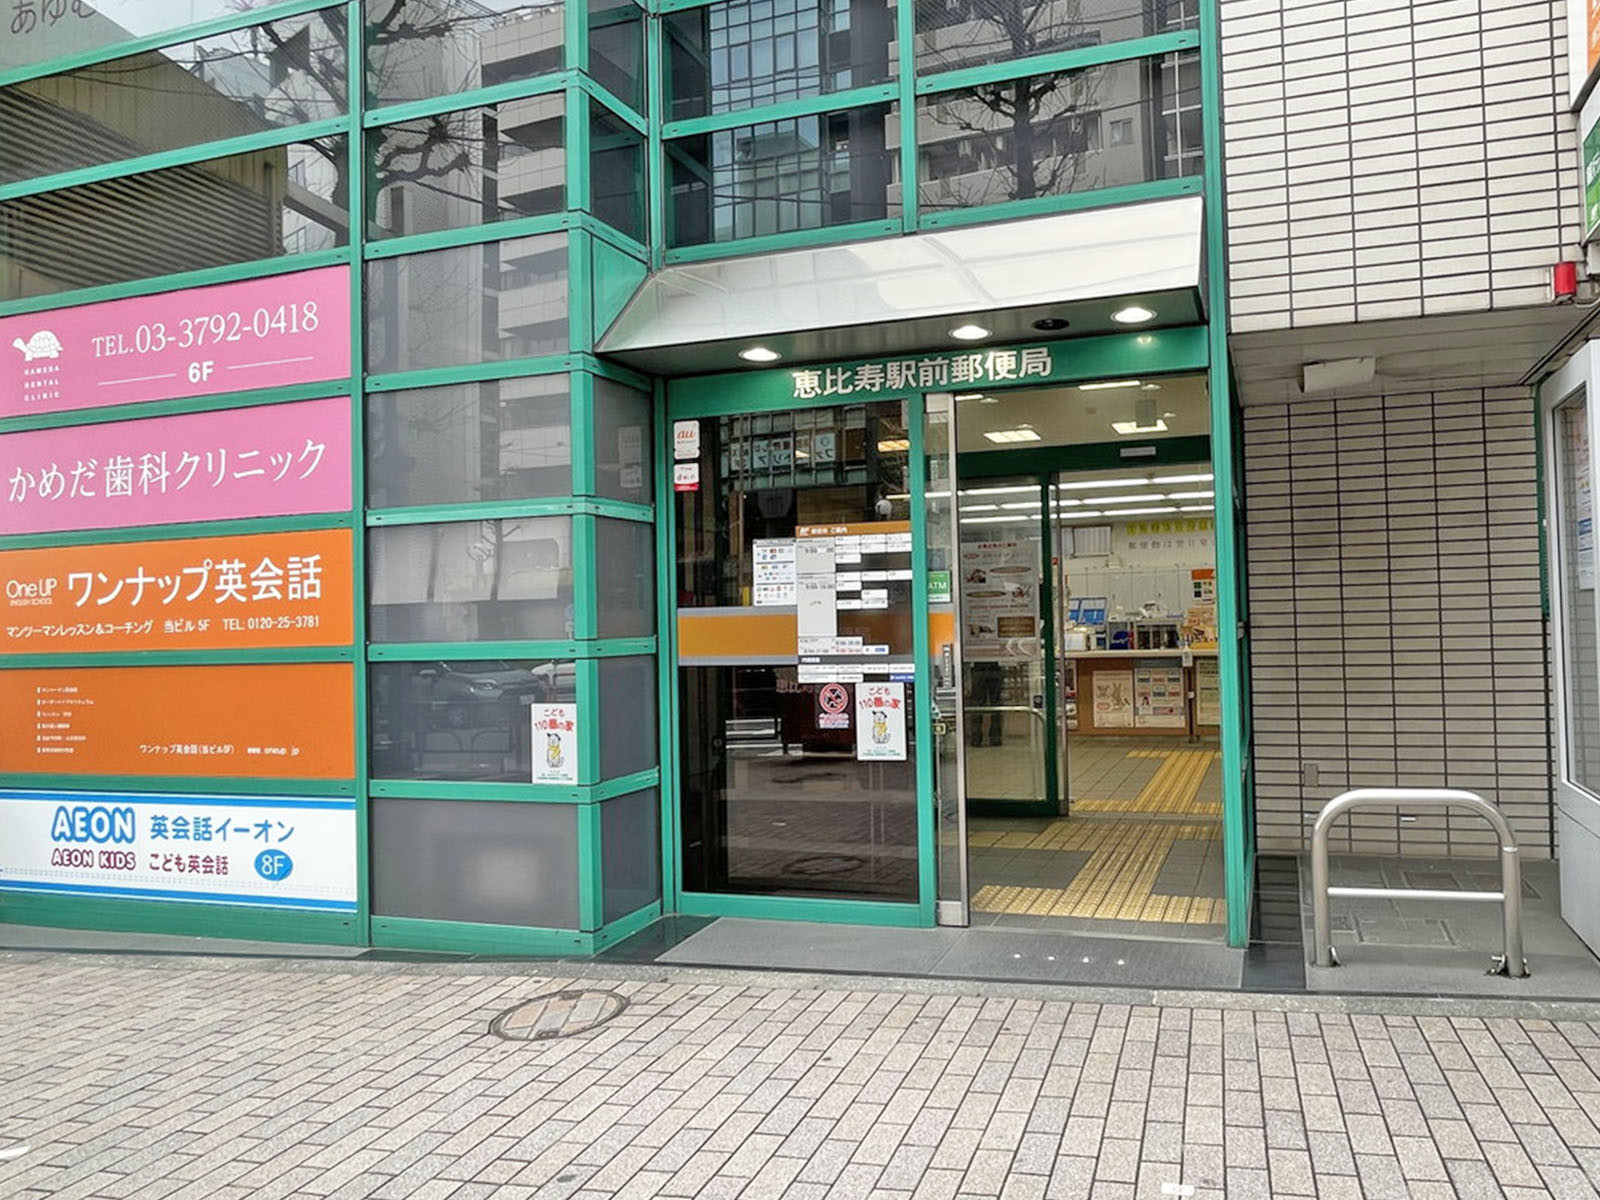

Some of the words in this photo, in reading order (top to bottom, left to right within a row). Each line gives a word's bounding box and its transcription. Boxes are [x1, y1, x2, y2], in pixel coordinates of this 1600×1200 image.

[188, 361, 214, 383] 6F
[792, 347, 1052, 399] 恵比寿駅前郵便局
[676, 429, 695, 440] au
[9, 438, 326, 503] かめだ歯科クリニック
[68, 554, 322, 607] ワンナップ英会話
[928, 581, 948, 590] ATM
[164, 618, 195, 634] 当ビル
[198, 619, 210, 631] 5F
[247, 615, 319, 630] 0120-25-3781
[869, 687, 891, 696] こども
[544, 708, 565, 717] こども
[51, 806, 136, 844] AEON
[150, 815, 295, 843] 英会話イーオン
[51, 848, 94, 868] AEON
[98, 850, 136, 870] KIDS
[149, 853, 229, 875] こども英会話
[261, 854, 286, 875] 8F
